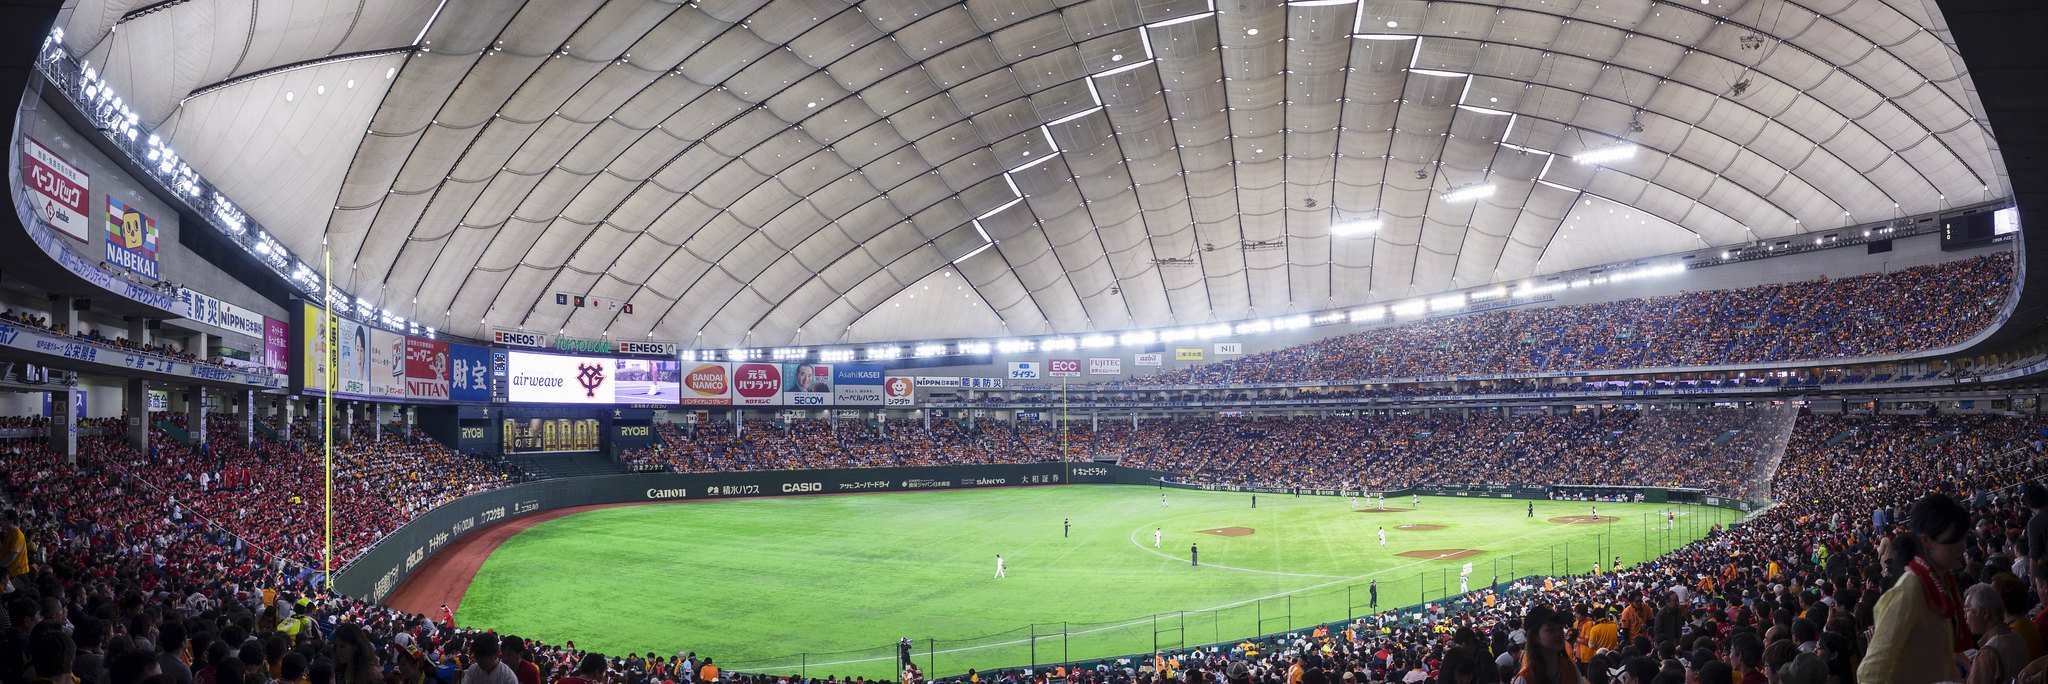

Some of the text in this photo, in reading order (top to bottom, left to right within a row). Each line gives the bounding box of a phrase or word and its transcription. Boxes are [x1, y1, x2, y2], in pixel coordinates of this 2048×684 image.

[32, 165, 80, 208] ベースパック
[503, 333, 534, 345] ENEOS
[556, 337, 612, 354] TOKYO DOME
[630, 343, 663, 353] ENEOS
[407, 347, 433, 362] ニッタン
[1052, 361, 1076, 371] ECC
[453, 359, 487, 390] 財宝
[513, 372, 564, 388] airweave
[748, 370, 767, 380] 元気
[962, 377, 1001, 388] 能美防災
[407, 381, 448, 397] NITTAN
[462, 428, 484, 439] RYOBI
[621, 427, 649, 436] RYOBI
[976, 477, 1005, 485] SANKYO
[1021, 474, 1059, 484] 大和証券
[647, 488, 686, 498] Canon
[723, 485, 760, 494] 積水ハウス
[782, 482, 822, 493] CASIO
[486, 506, 505, 522] フコク生命
